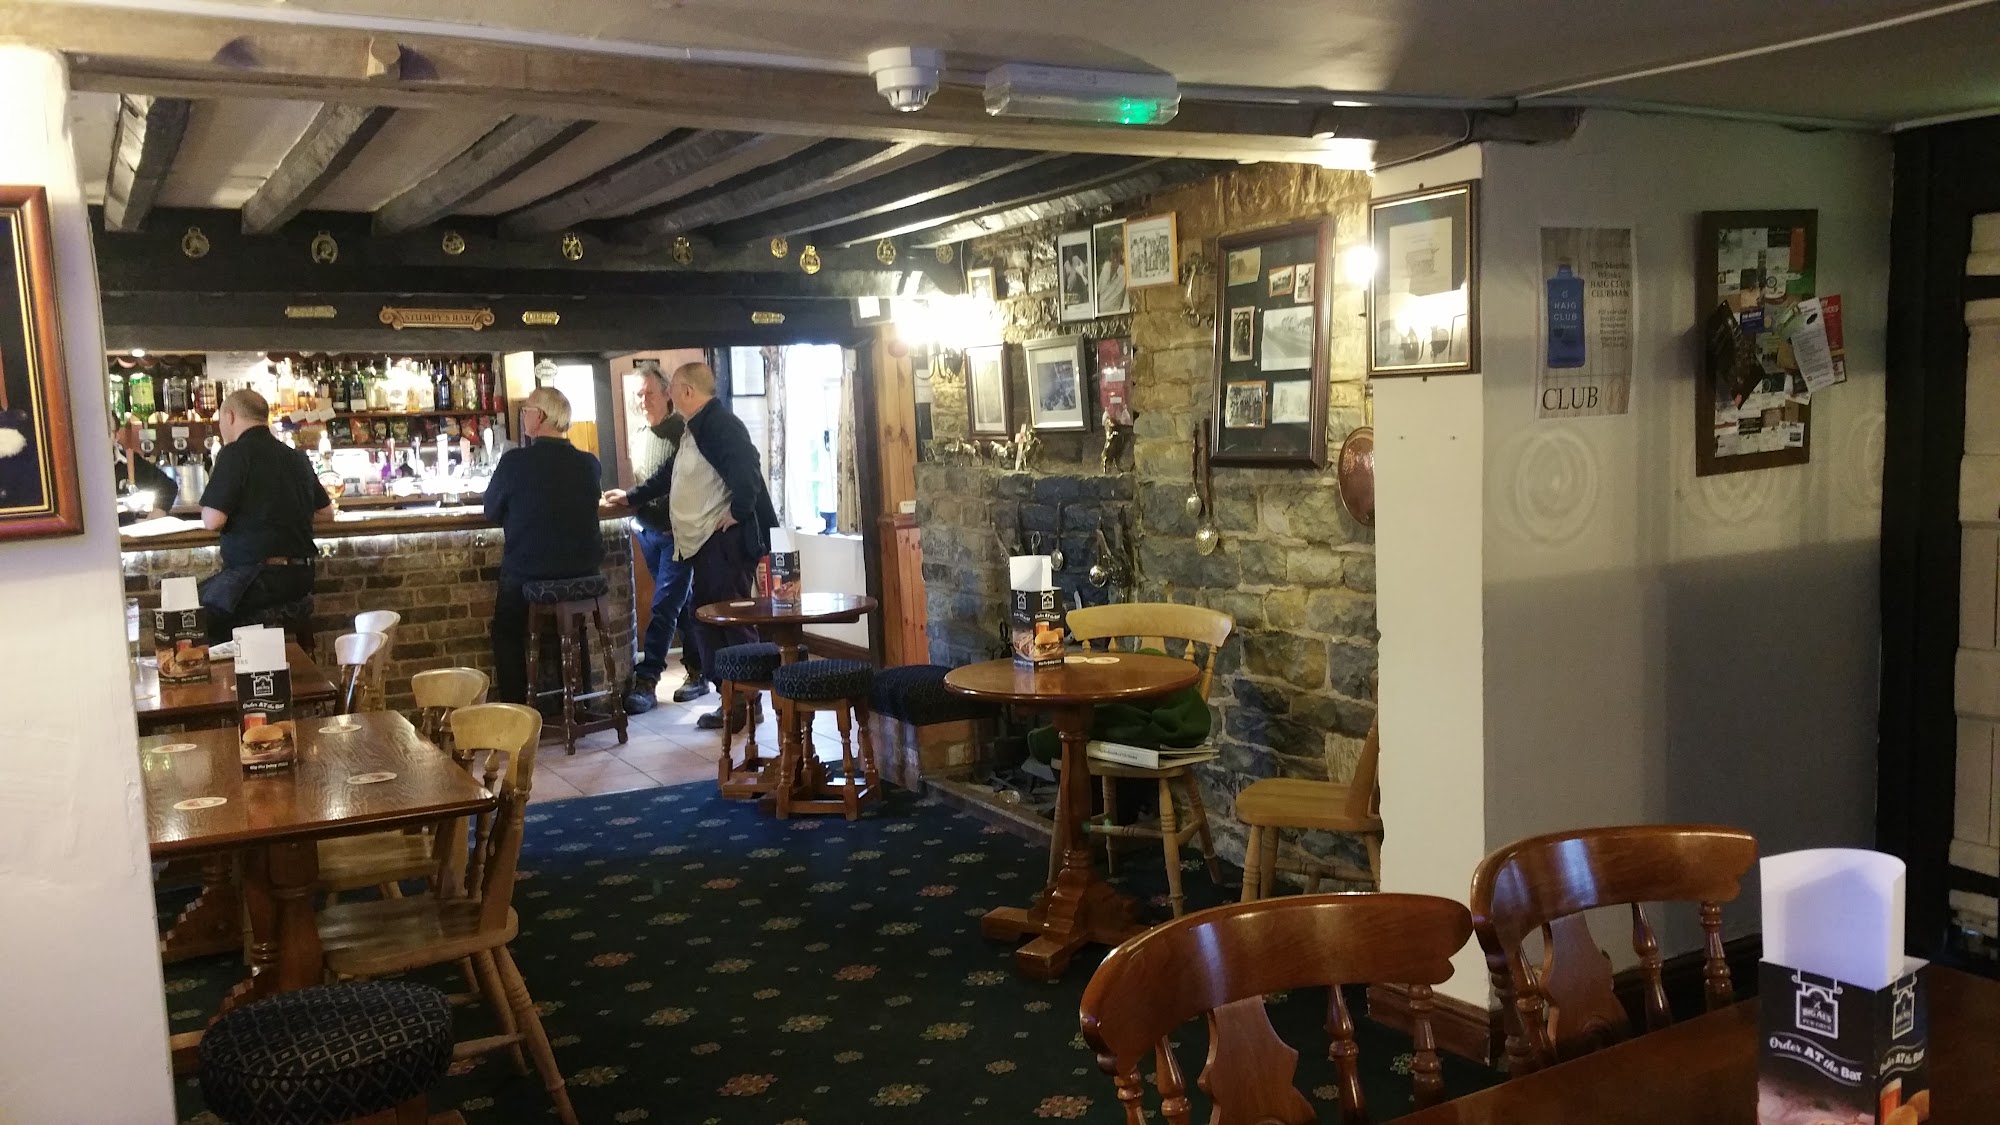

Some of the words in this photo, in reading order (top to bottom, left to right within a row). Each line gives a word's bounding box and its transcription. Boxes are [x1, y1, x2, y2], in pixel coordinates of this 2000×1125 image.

[1553, 313, 1577, 321] CLUB
[1542, 386, 1598, 410] CLUB
[1769, 1036, 1802, 1054] Order
[1804, 1046, 1825, 1063] AT
[1823, 1059, 1839, 1075] the
[1840, 1065, 1862, 1082] Bar
